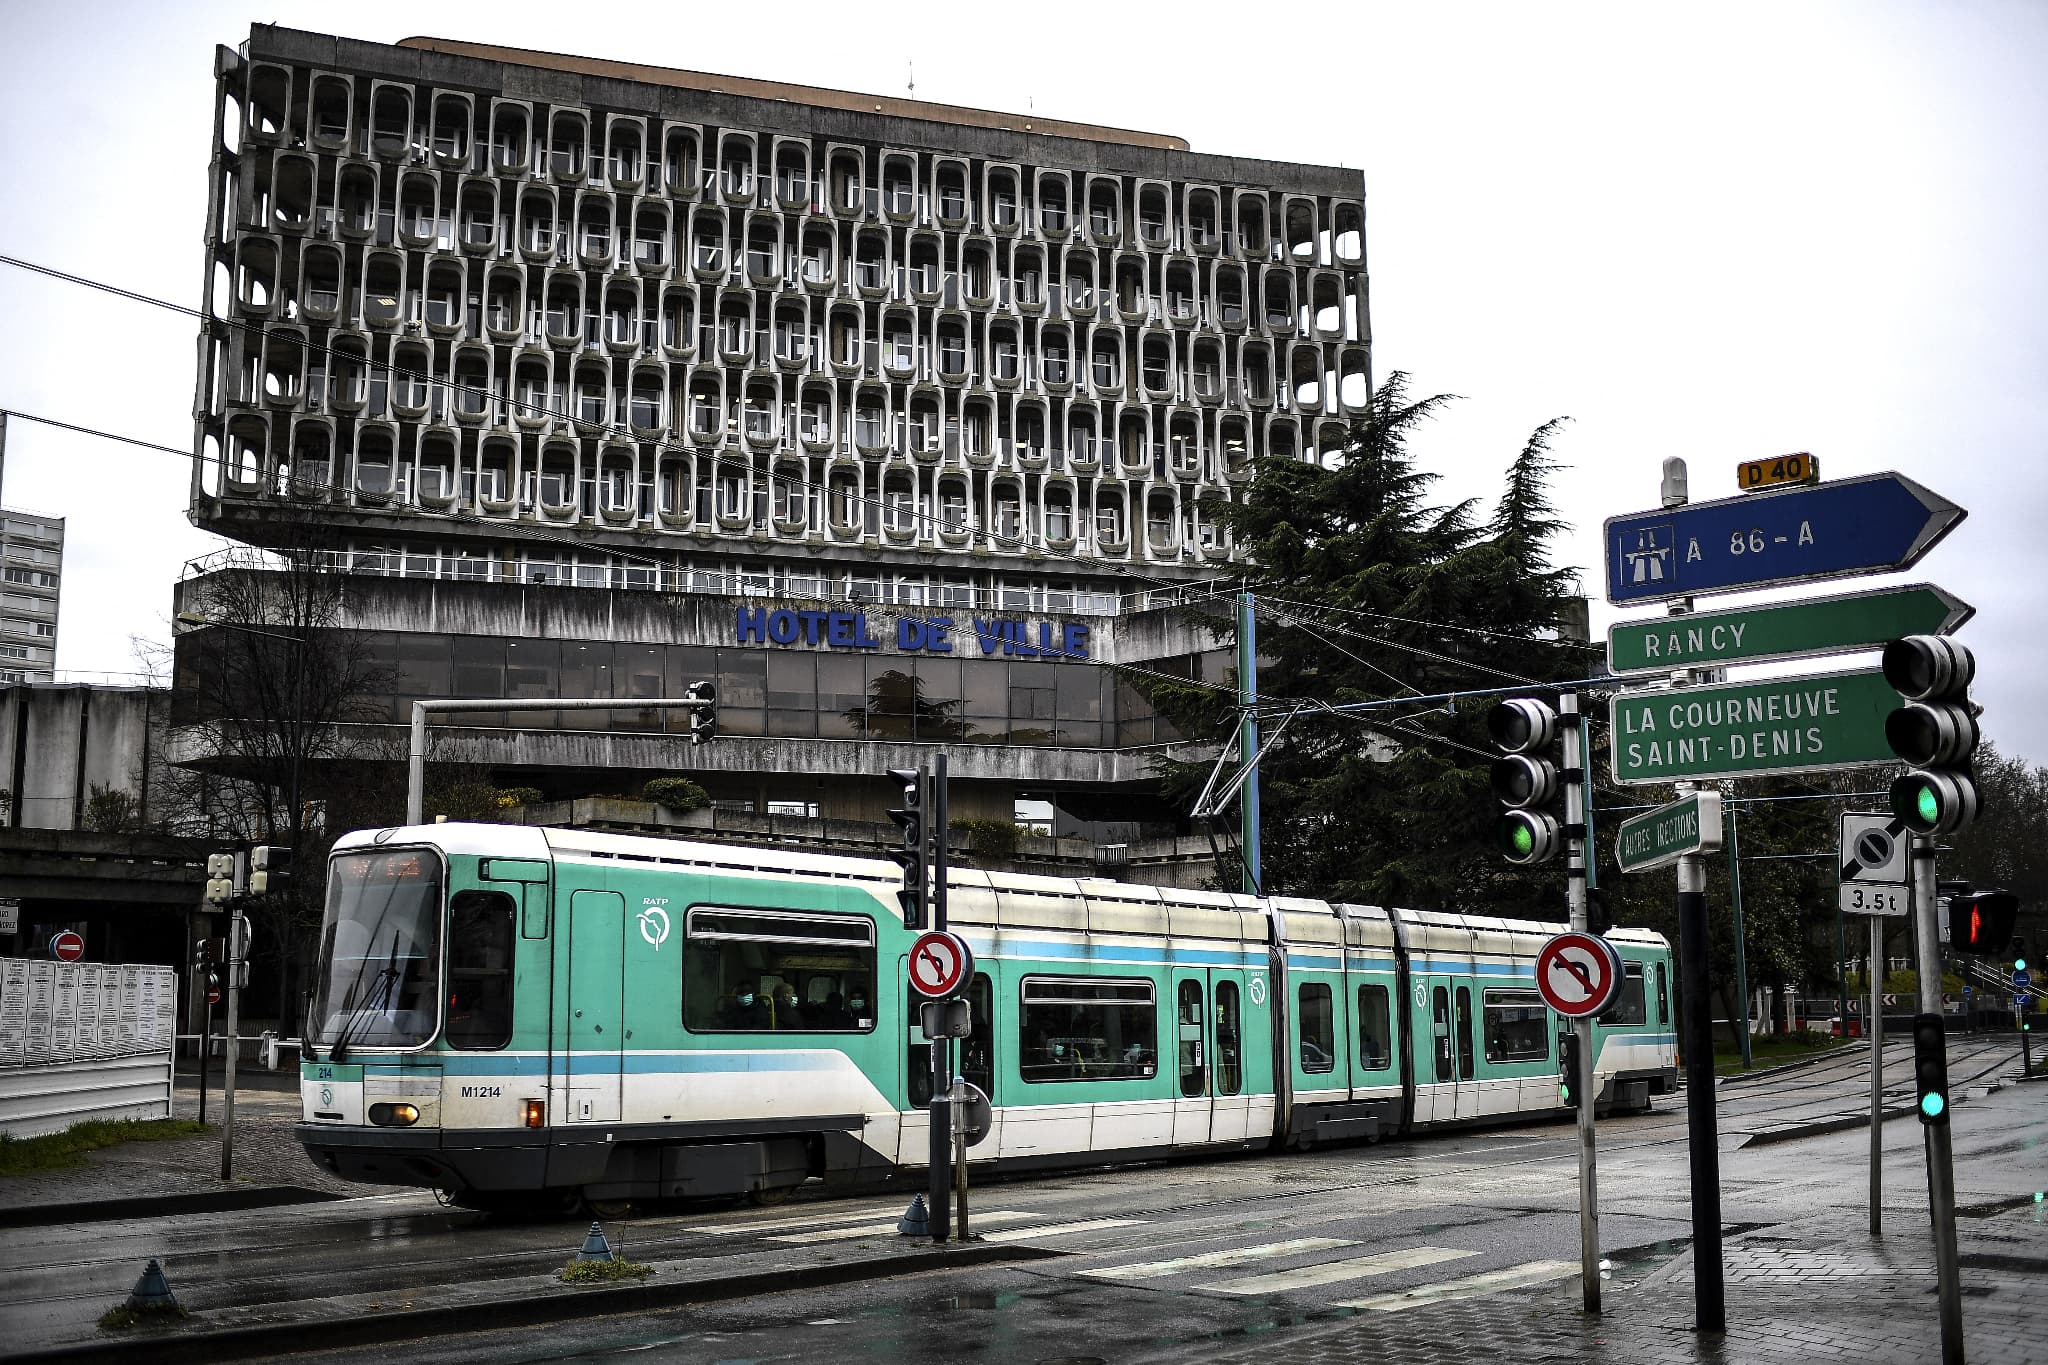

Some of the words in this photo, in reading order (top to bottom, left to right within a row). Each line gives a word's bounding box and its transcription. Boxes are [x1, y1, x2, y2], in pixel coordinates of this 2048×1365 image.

[1748, 464, 1762, 485] D
[1771, 457, 1802, 480] 40
[1686, 537, 1702, 563] A
[736, 606, 880, 648] HOTEL
[897, 616, 953, 652] DE
[973, 619, 1090, 658] VILLE
[1624, 707, 1656, 734] LA
[1668, 688, 1841, 730] COURNEUVE
[1627, 727, 1824, 768] SAINT-DENIS
[1625, 827, 1651, 858] AUTRES
[642, 896, 669, 905] RATP
[319, 1067, 332, 1079] 214
[461, 1086, 502, 1099] M1214
